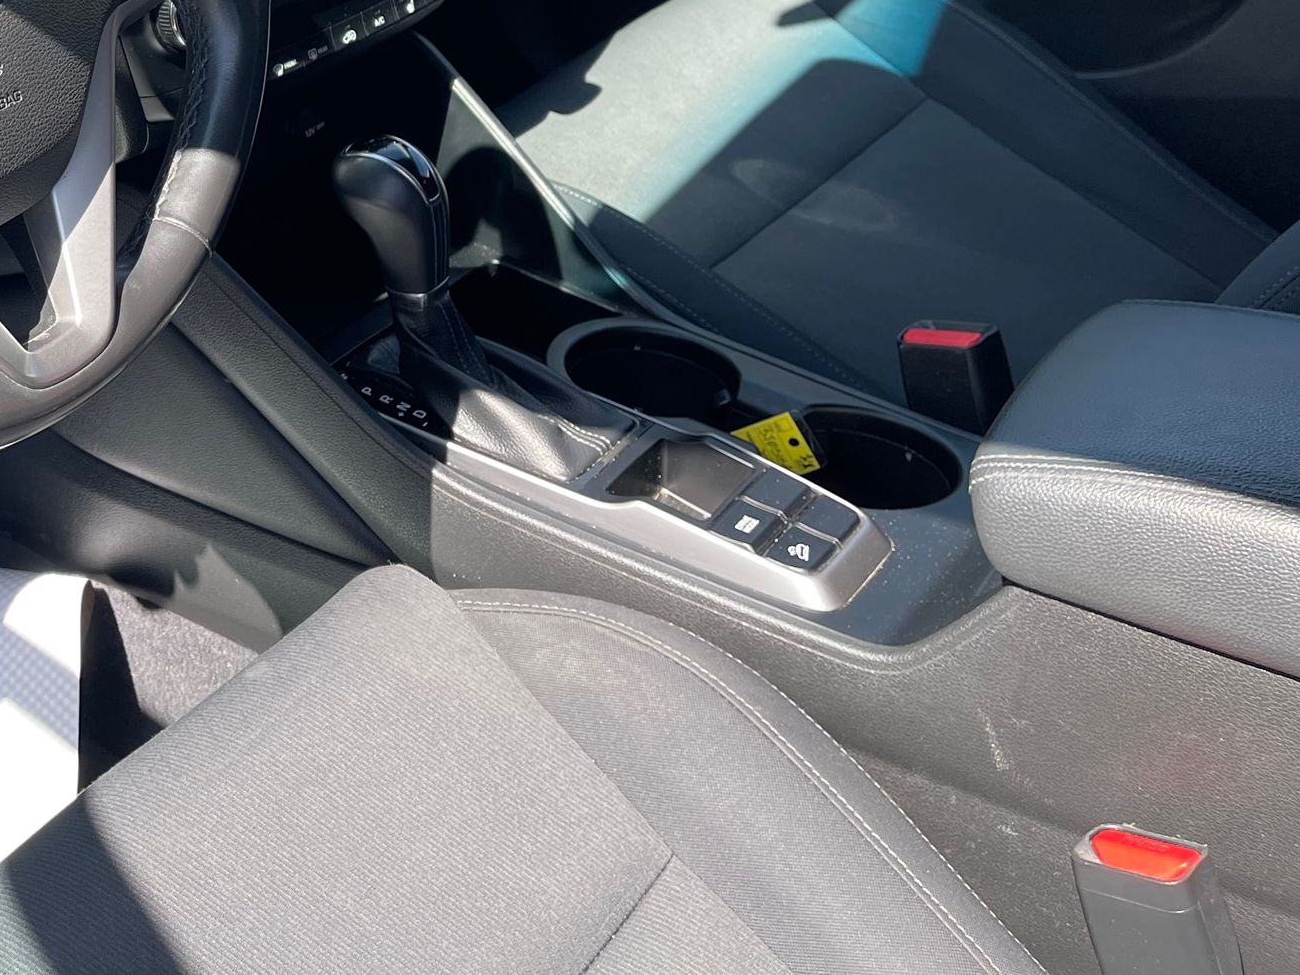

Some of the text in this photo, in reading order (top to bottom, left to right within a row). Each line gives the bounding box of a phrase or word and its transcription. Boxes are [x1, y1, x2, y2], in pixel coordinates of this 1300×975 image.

[361, 386, 372, 396] P
[379, 394, 394, 404] R
[396, 401, 411, 412] N
[413, 409, 426, 418] D
